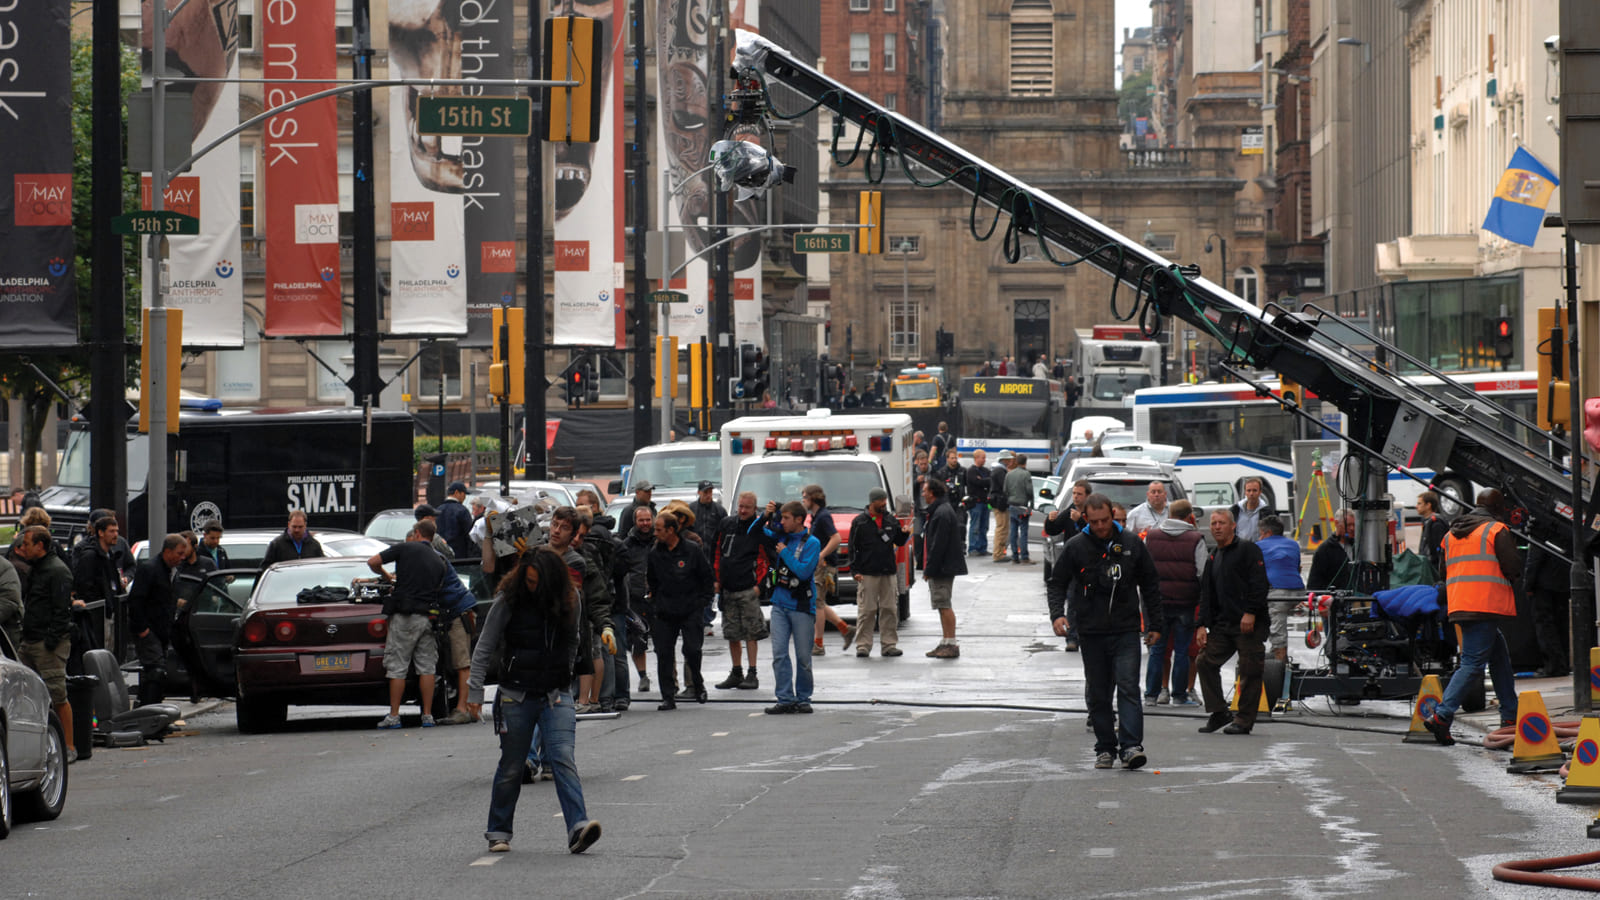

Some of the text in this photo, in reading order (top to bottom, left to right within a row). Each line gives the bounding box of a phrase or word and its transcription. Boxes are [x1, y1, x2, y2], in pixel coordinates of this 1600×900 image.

[268, 43, 319, 167] mask
[437, 105, 512, 128] 15th St
[461, 135, 501, 211] ask
[33, 186, 67, 201] MAY
[33, 202, 67, 216] OCT
[309, 214, 335, 224] MAY
[404, 210, 430, 222] MAY
[130, 217, 182, 232] 15th ST
[307, 224, 335, 235] OCT
[804, 237, 842, 249] 16th St
[492, 248, 513, 257] MAY
[564, 247, 586, 257] MAY
[170, 280, 217, 288] ADELPHIA
[398, 279, 448, 287] PHILADELPHIA
[653, 294, 680, 302] 16th ST
[973, 382, 1034, 395] 64 AIRPORT
[1389, 444, 1409, 462] 355
[287, 474, 356, 484] PHILADELPHIA POLICE
[287, 483, 357, 514] S.W.A.T.
